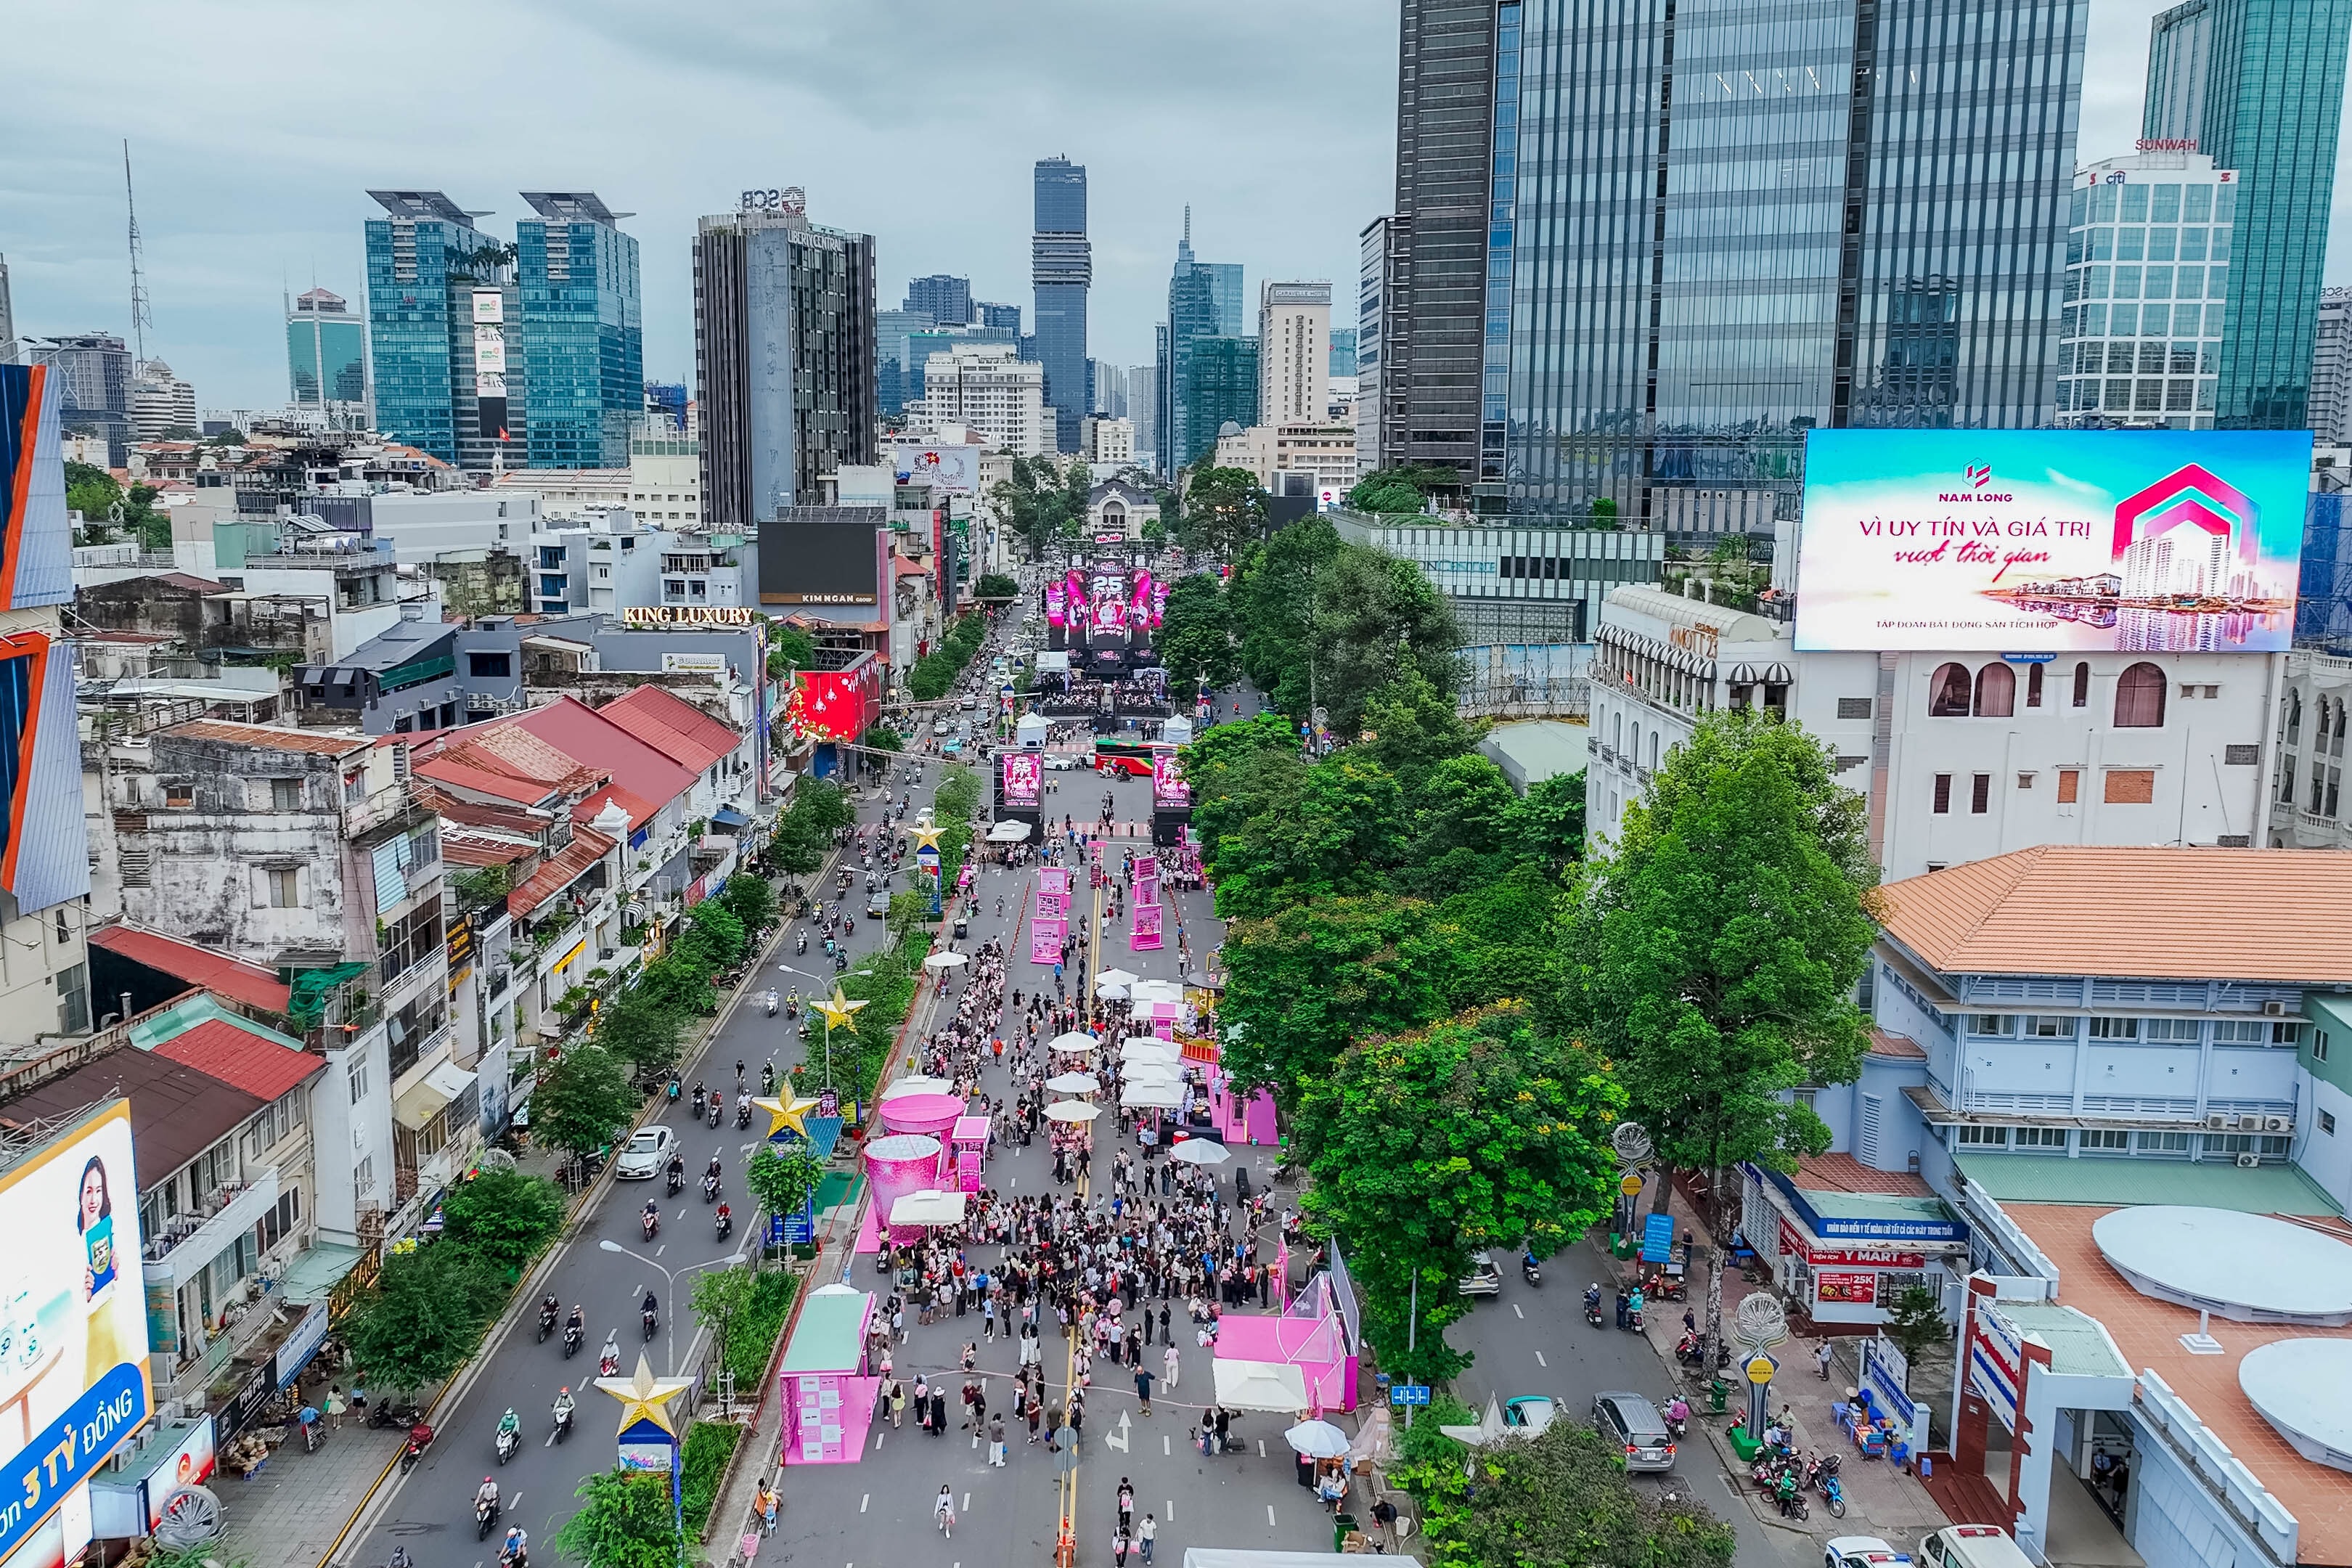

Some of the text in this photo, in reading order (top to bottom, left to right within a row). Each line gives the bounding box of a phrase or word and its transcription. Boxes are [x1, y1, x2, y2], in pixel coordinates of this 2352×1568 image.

[2135, 139, 2197, 150] SUNWAH
[2106, 171, 2126, 185] citi
[787, 229, 844, 252] LIBERTY CENTRAL
[1939, 494, 2013, 502] NAM LONG
[1859, 516, 2091, 540] VÌ UY TÍN VÀ GIÁ TRỊ
[1991, 547, 2052, 583] gian
[1093, 576, 1126, 592] 25
[624, 607, 754, 624] KING LUXURY
[1845, 1250, 1900, 1262] Y MART
[1853, 1275, 1874, 1284] 25K
[22, 1465, 41, 1510] 3
[42, 1423, 78, 1489] TỶ
[82, 1387, 133, 1455] ĐỒNG
